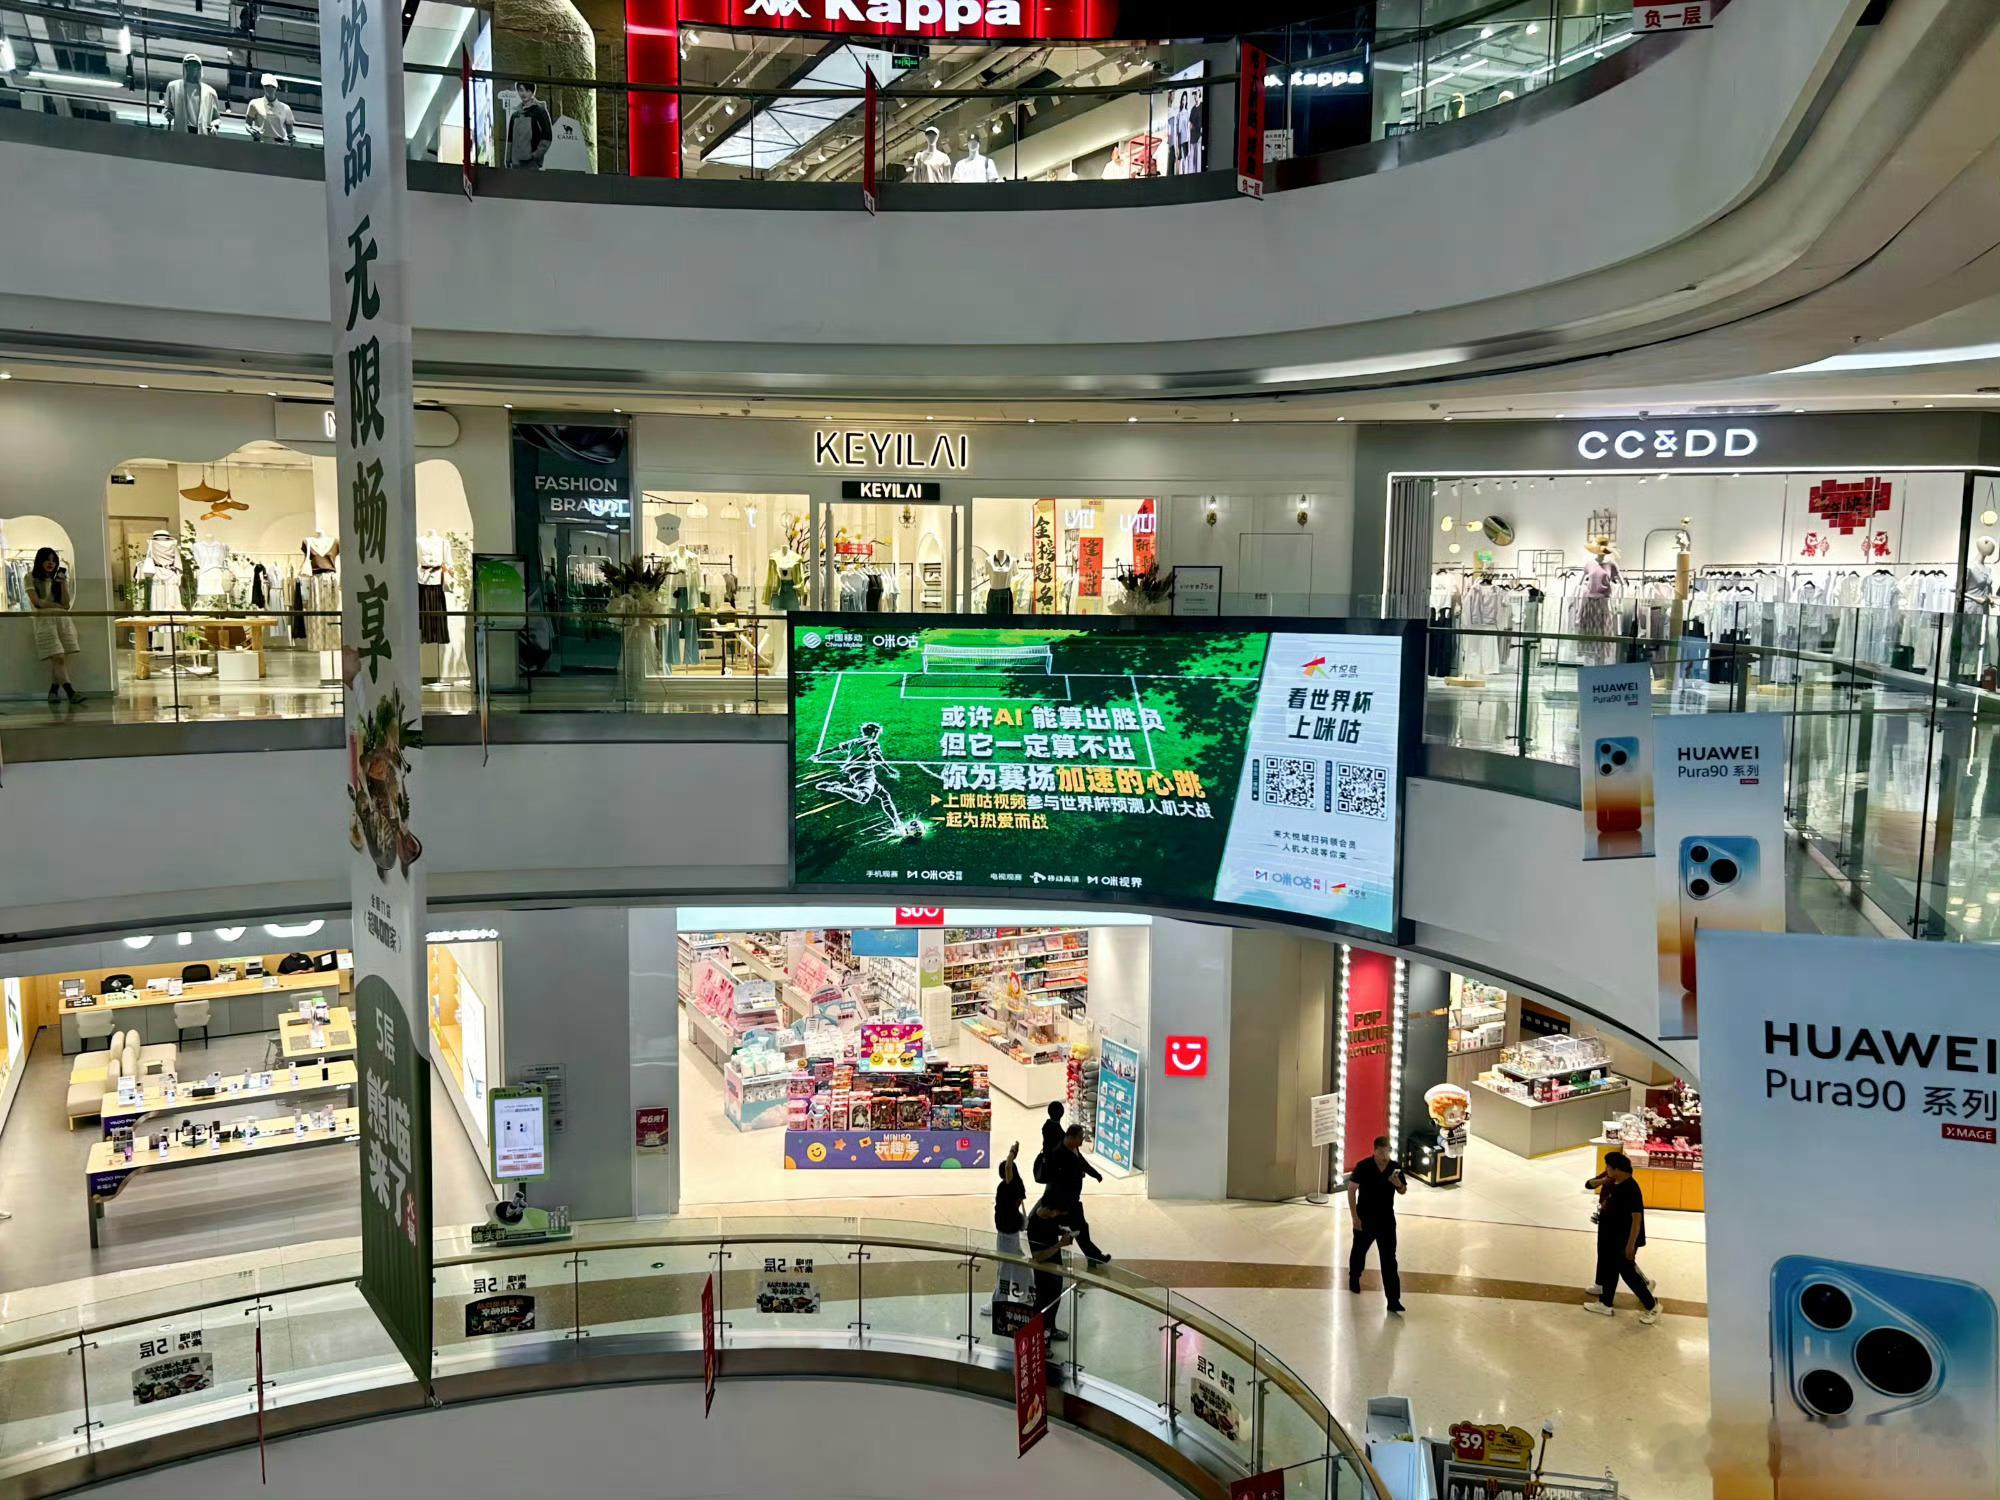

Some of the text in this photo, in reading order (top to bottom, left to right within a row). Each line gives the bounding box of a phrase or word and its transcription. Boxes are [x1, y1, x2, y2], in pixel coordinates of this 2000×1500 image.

[825, 0, 1021, 31] Kappa
[1644, 6, 1702, 28] 负一层
[1291, 70, 1364, 88] Kappa
[1242, 178, 1260, 196] 负一层
[345, 214, 393, 685] 无限畅享
[814, 430, 968, 468] KEYILAI
[1578, 428, 1758, 459] CC&DD
[534, 475, 617, 492] FASHION
[860, 482, 922, 498] KEYILAI
[825, 633, 863, 642] 中国移动
[872, 634, 918, 648] 咪咕
[1592, 682, 1638, 693] HUAWEI
[1288, 687, 1374, 714] 看世界杯
[1593, 694, 1622, 704] Pura90
[1288, 715, 1363, 744] 上咪咕
[939, 732, 1136, 762] 但它一定算不出
[1678, 746, 1759, 761] HUAWEI
[1678, 764, 1759, 779] Pura90 系列
[941, 763, 1206, 800] 你为赛场加速的心跳
[943, 793, 1215, 820] 上咪咕视频参与世界杯预测人机大战
[930, 812, 1049, 831] 一起为热爱而战
[1273, 829, 1357, 850] 来大悦城扫码领会员
[1282, 843, 1348, 860] 人机大战等你来
[1353, 1009, 1383, 1028] POP
[375, 1007, 395, 1066] 5层
[1764, 1020, 1998, 1075] HUAWEI
[1766, 1068, 1998, 1122] Pura90 系列
[883, 1132, 912, 1142] MINISO
[1946, 1127, 1993, 1141] XMAGE
[875, 1141, 920, 1154] 玩趣季
